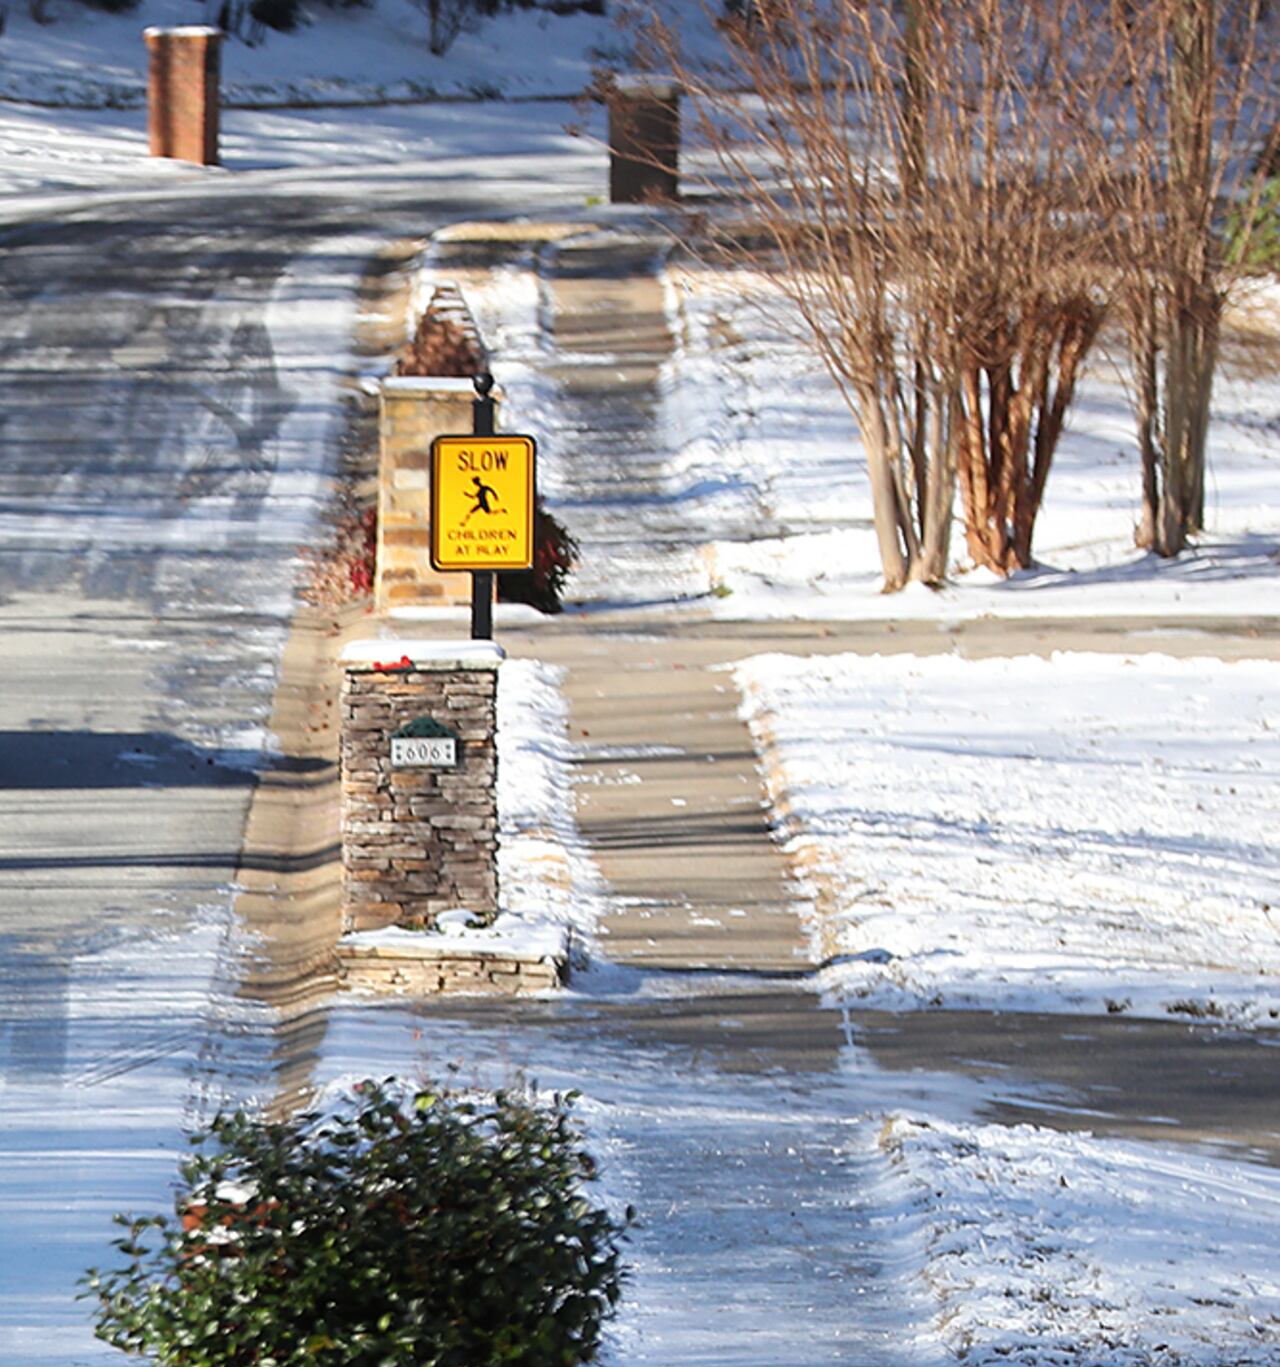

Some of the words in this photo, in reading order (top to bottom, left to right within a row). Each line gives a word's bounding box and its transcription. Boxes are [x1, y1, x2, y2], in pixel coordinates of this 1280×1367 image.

[458, 450, 508, 471] SLOW
[448, 530, 517, 540] CHILDREN
[456, 546, 471, 555] AT
[407, 744, 440, 759] 606
